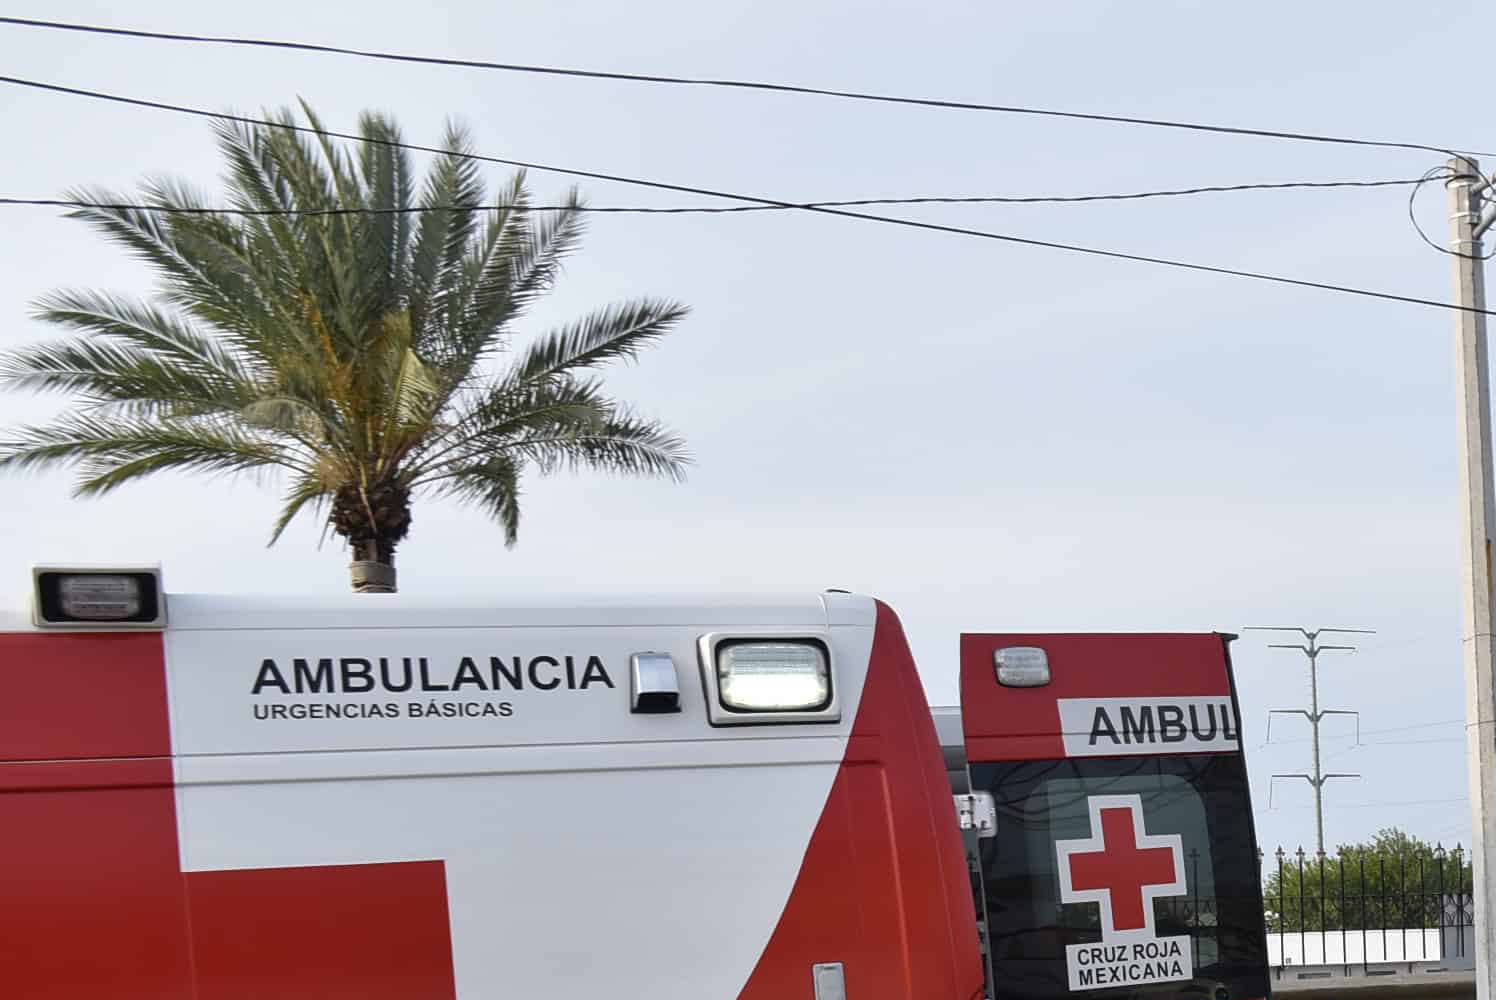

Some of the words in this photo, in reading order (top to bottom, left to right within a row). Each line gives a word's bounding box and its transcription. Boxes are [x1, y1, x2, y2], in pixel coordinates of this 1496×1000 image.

[251, 655, 616, 694] AMBULANCIA
[253, 702, 400, 719] URGENCIAS
[407, 699, 513, 718] BÁSICAS
[1088, 704, 1238, 745] AMBUL
[1078, 945, 1128, 965] CRUZ
[1133, 941, 1181, 960] ROJA
[1079, 961, 1183, 986] MEXICANA
